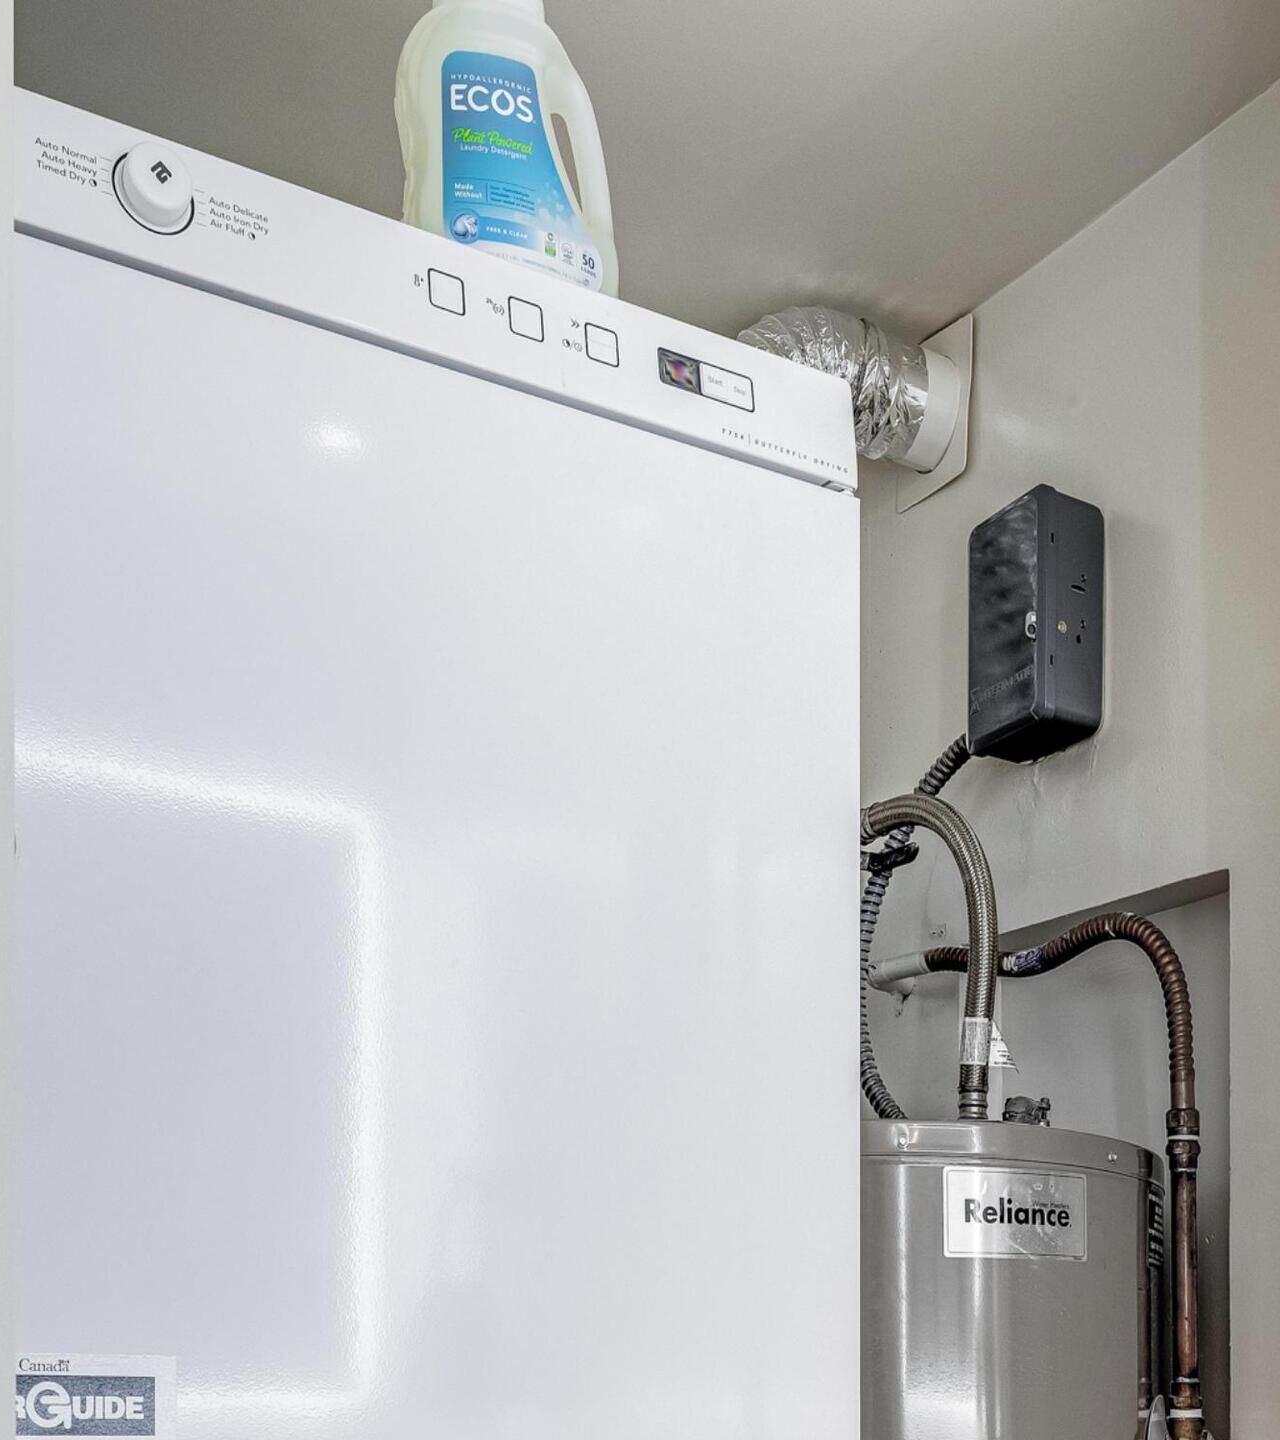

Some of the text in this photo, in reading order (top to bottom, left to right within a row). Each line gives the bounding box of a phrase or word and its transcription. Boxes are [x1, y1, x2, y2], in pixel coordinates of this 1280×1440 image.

[449, 83, 534, 123] ECOS
[34, 136, 97, 164] Auto Normal
[452, 127, 534, 155] Plant Powered
[36, 159, 87, 184] Timed Dry
[41, 151, 97, 177] Auto Heavy
[208, 196, 269, 222] Auto Delicate
[209, 208, 269, 235] Auto Iron Dry
[209, 219, 245, 236] Air Fluff
[581, 253, 596, 270] 50
[963, 1196, 1071, 1228] Reliance
[18, 1358, 70, 1372] Canada
